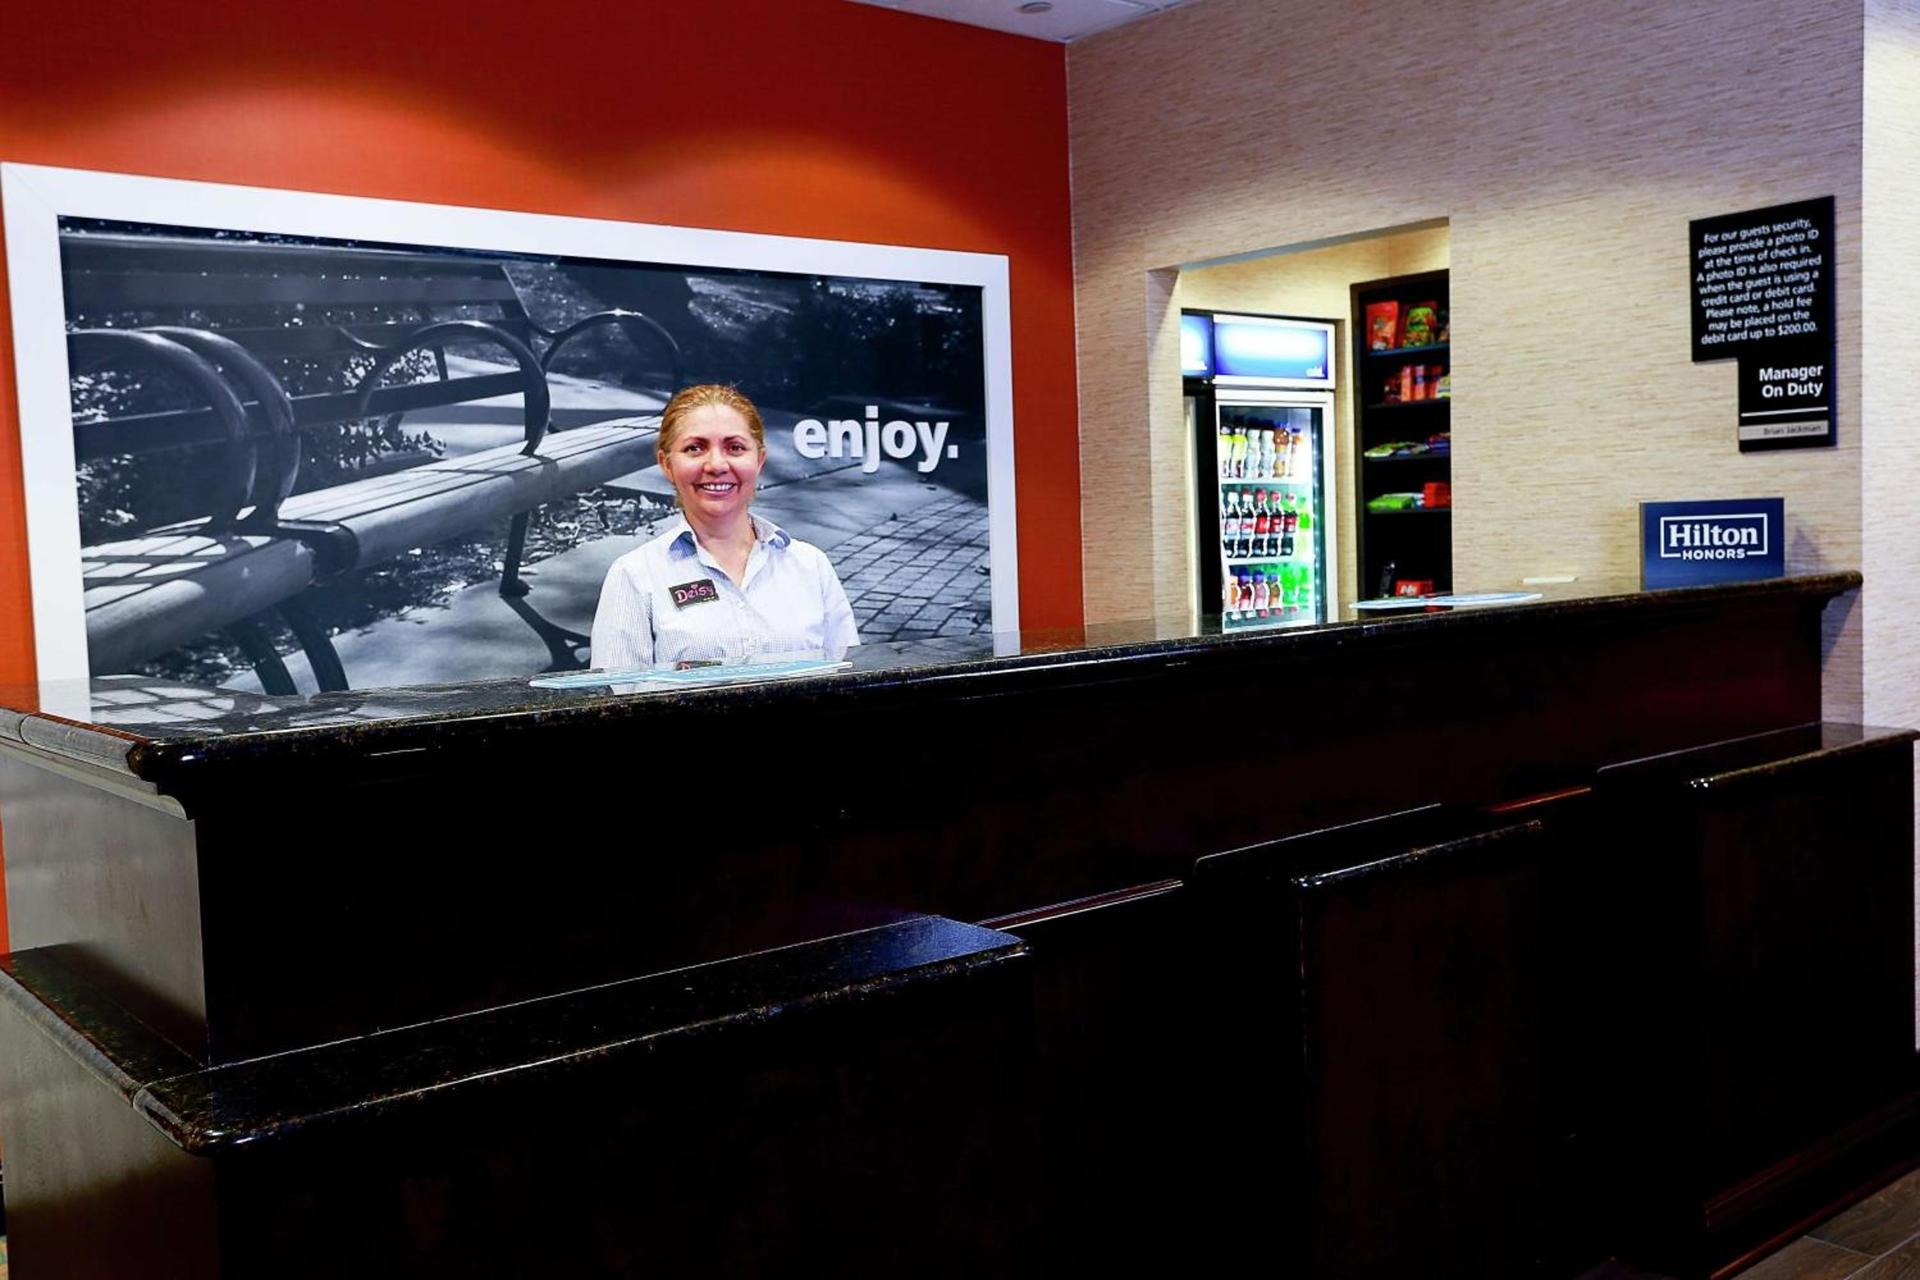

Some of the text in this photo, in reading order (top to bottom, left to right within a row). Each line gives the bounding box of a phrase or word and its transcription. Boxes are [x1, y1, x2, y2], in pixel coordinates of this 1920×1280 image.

[1698, 246, 1727, 258] please
[1729, 238, 1764, 253] provide
[1775, 233, 1805, 246] photo
[1807, 229, 1819, 239] ID
[1704, 234, 1719, 243] For
[1721, 231, 1737, 241] our
[1697, 254, 1821, 282] A photo ID is also required
[1704, 259, 1714, 269] at
[1716, 257, 1732, 266] the
[1734, 254, 1755, 264] time
[1757, 250, 1768, 260] of
[1770, 245, 1797, 258] check
[1699, 270, 1819, 294] when the guest is using a
[1701, 295, 1727, 307] credit
[1729, 292, 1750, 303] card
[1752, 291, 1762, 300] or
[1765, 286, 1790, 298] debit
[1706, 308, 1734, 319] Please
[1763, 303, 1769, 312] a
[1772, 299, 1793, 310] hold
[1796, 296, 1812, 307] fee
[1708, 311, 1810, 331] may be placed on the
[1701, 333, 1725, 344] debit
[1727, 330, 1747, 341] card
[1749, 330, 1762, 339] up
[1765, 327, 1776, 337] to
[1759, 365, 1823, 381] Manager
[1762, 382, 1823, 398] On Duty
[793, 405, 958, 473] enjoy.
[1669, 523, 1758, 547] Hilton
[1683, 548, 1745, 560] HONORS
